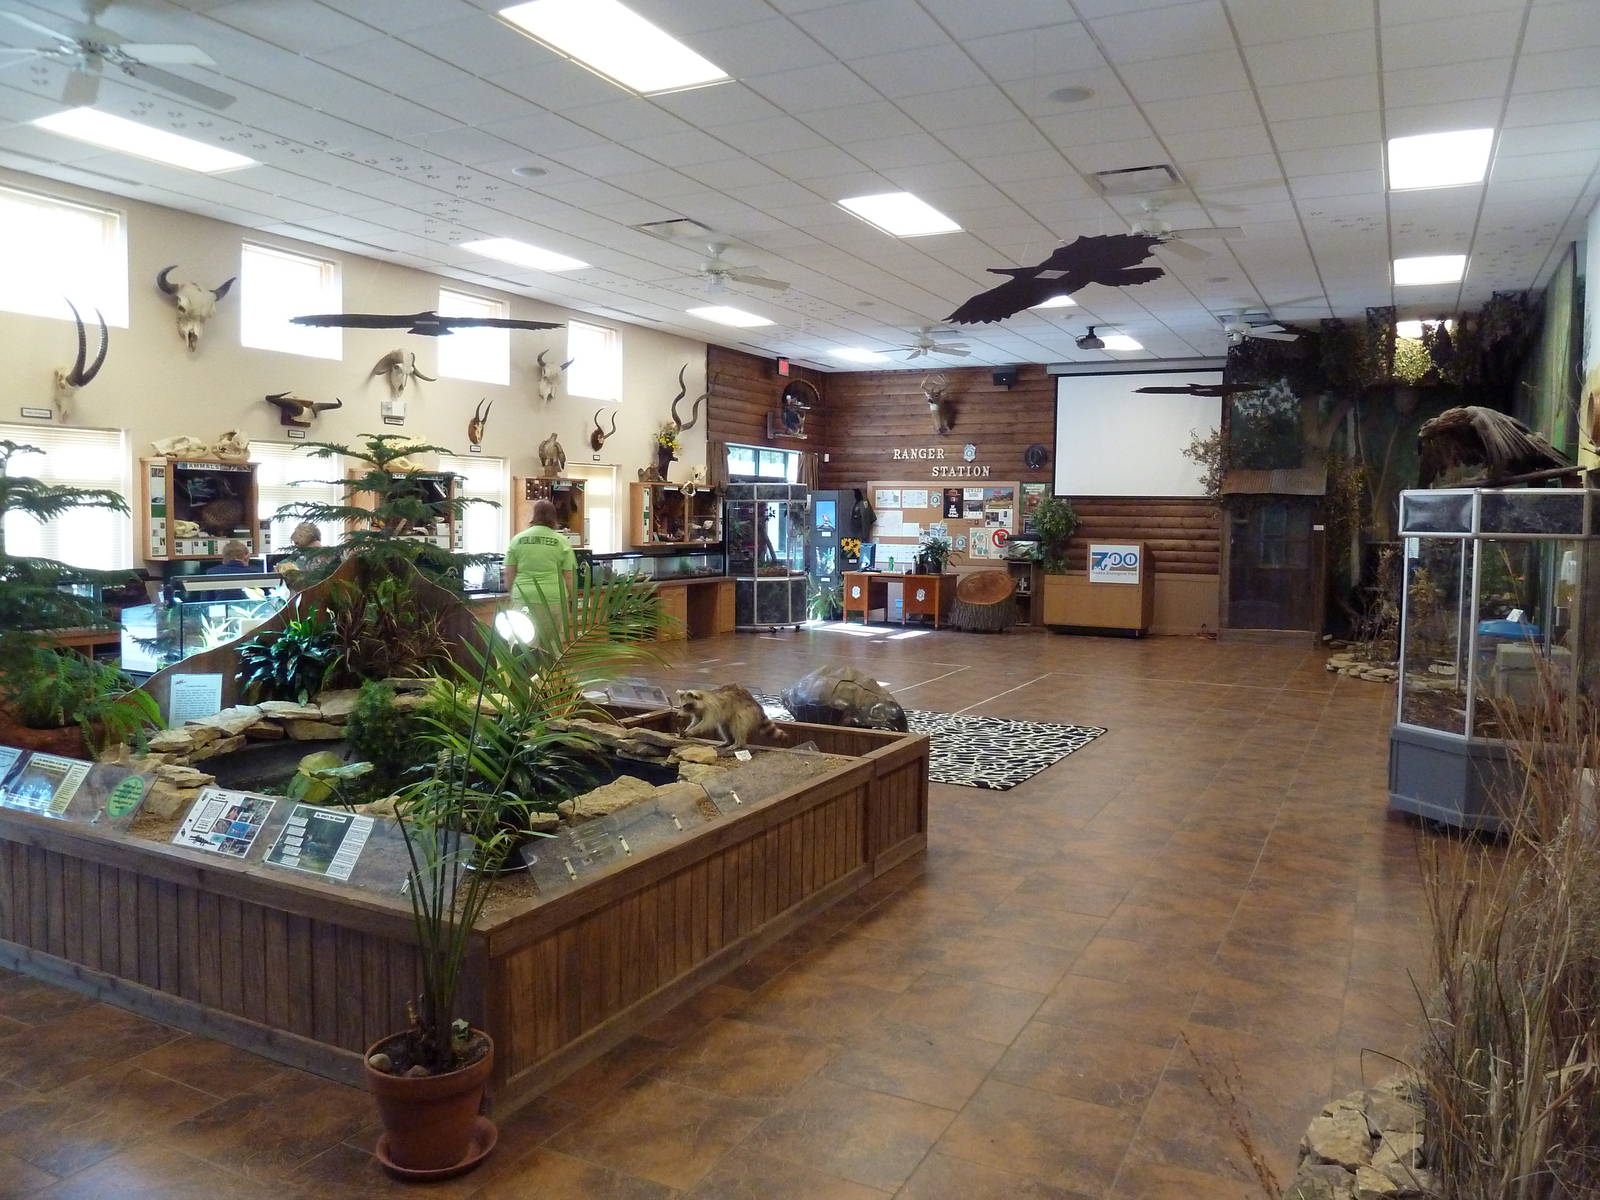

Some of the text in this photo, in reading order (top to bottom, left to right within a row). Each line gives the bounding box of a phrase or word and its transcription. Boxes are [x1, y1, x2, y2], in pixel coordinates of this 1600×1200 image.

[893, 448, 945, 460] RANGER
[931, 466, 991, 477] STATION
[518, 535, 559, 546] VOLUNTEER
